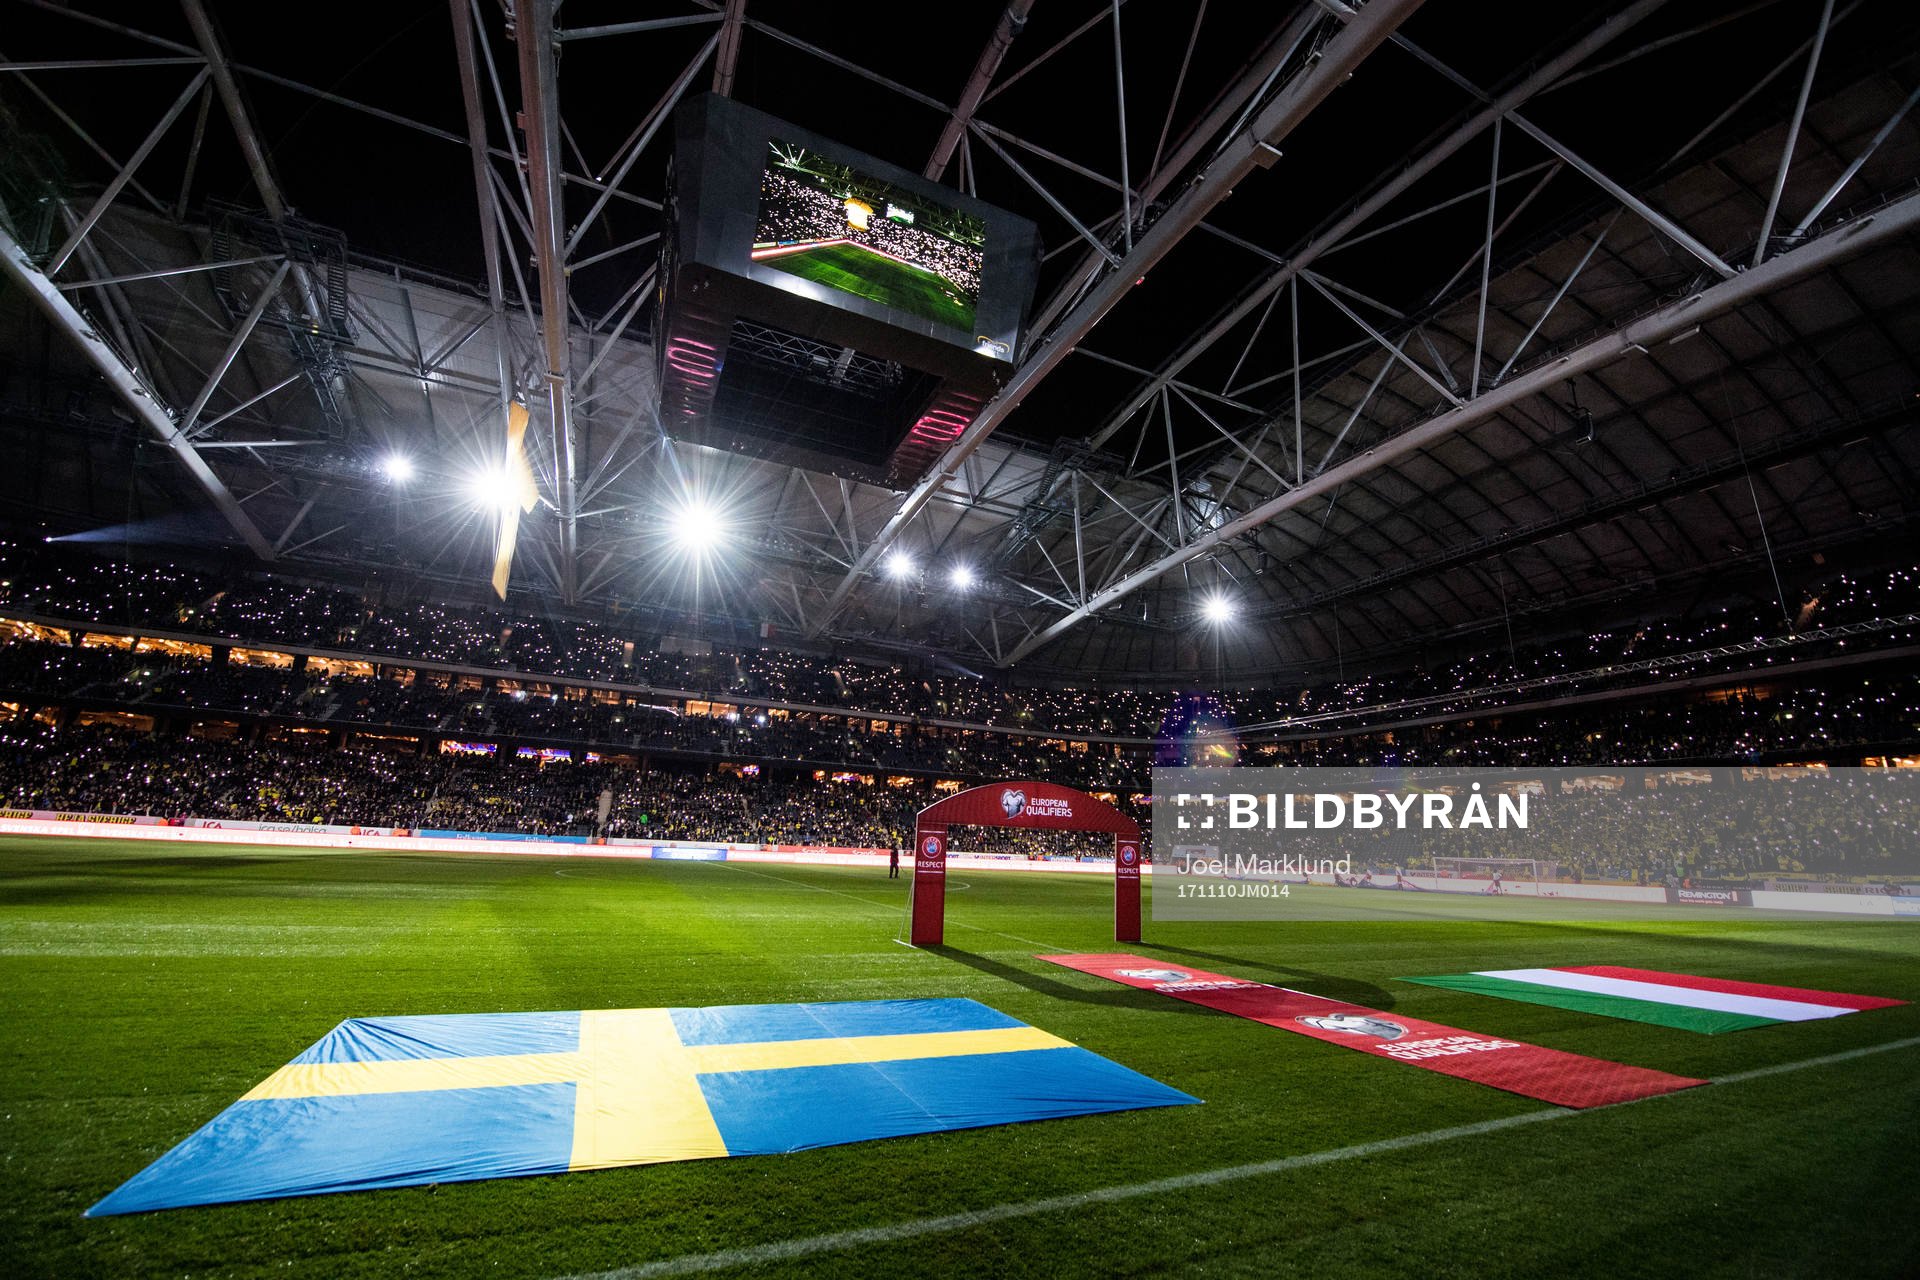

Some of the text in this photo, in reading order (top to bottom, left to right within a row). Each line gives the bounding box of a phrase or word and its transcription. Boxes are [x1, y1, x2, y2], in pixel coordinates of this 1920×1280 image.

[1031, 798, 1068, 808] EUROPEAN
[1026, 806, 1072, 817] QUALIFIERS
[87, 815, 136, 824] SVERIGE
[202, 821, 222, 829] ICA
[362, 829, 380, 837] ICA
[918, 860, 944, 868] RESPECT
[1678, 889, 1731, 900] REMINGTON
[1376, 1036, 1483, 1052] EUROPEAN
[1387, 1040, 1520, 1060] QUALIFIERS
